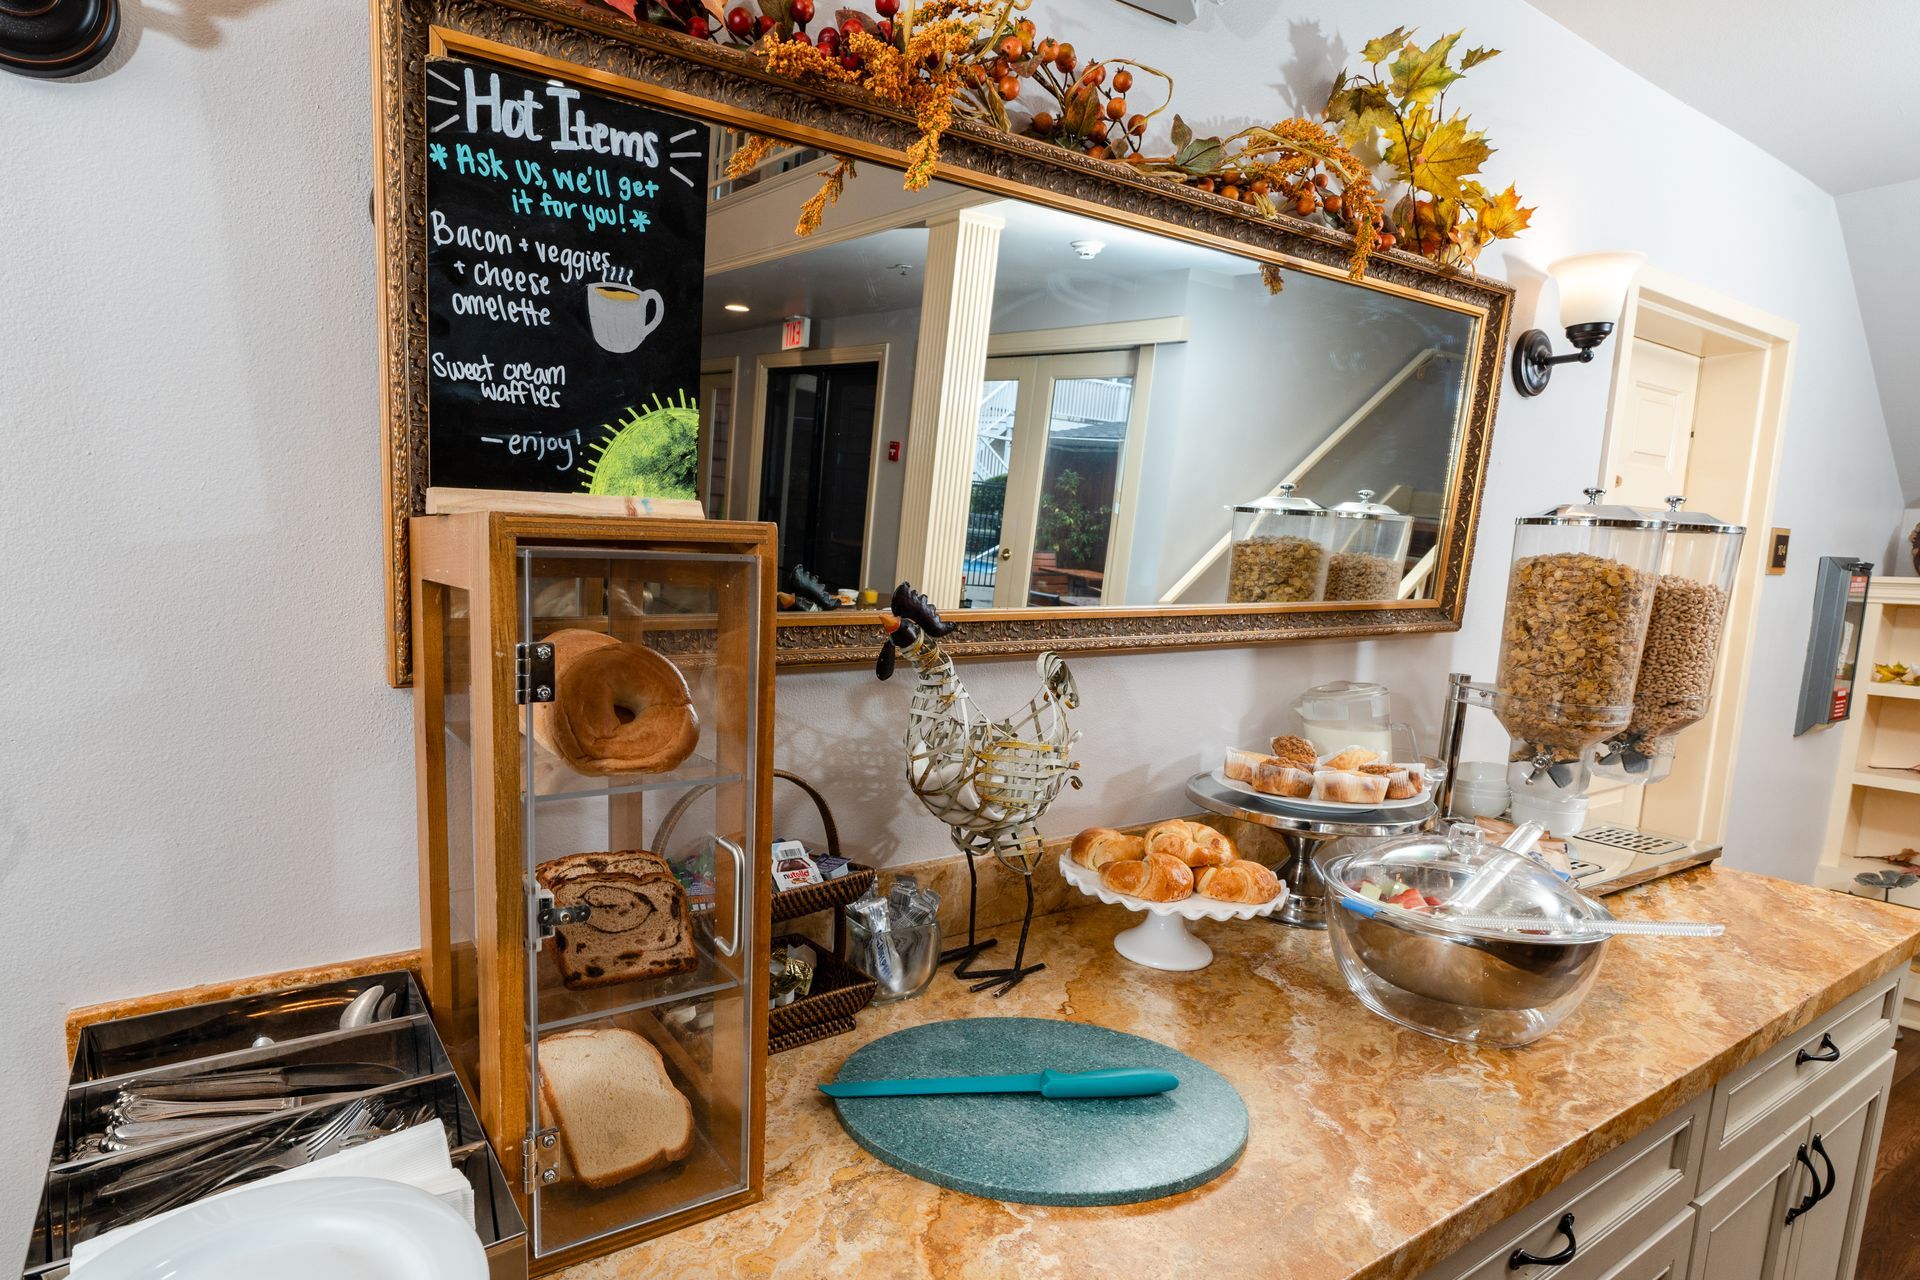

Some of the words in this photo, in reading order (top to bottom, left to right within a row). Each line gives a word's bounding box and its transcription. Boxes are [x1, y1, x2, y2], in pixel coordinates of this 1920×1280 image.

[464, 67, 543, 141] Hot
[546, 86, 659, 168] Items
[456, 144, 508, 180] Ask
[619, 177, 659, 201] get
[511, 189, 533, 214] it
[540, 193, 577, 218] for
[582, 204, 623, 232] you!
[430, 211, 511, 253] Bacon
[535, 242, 609, 283] veggies
[474, 260, 550, 295] cheese
[452, 292, 550, 326] omelette
[432, 352, 494, 381] Sweet
[503, 362, 565, 386] cream
[480, 380, 560, 408] waffles
[783, 870, 810, 880] nutella
